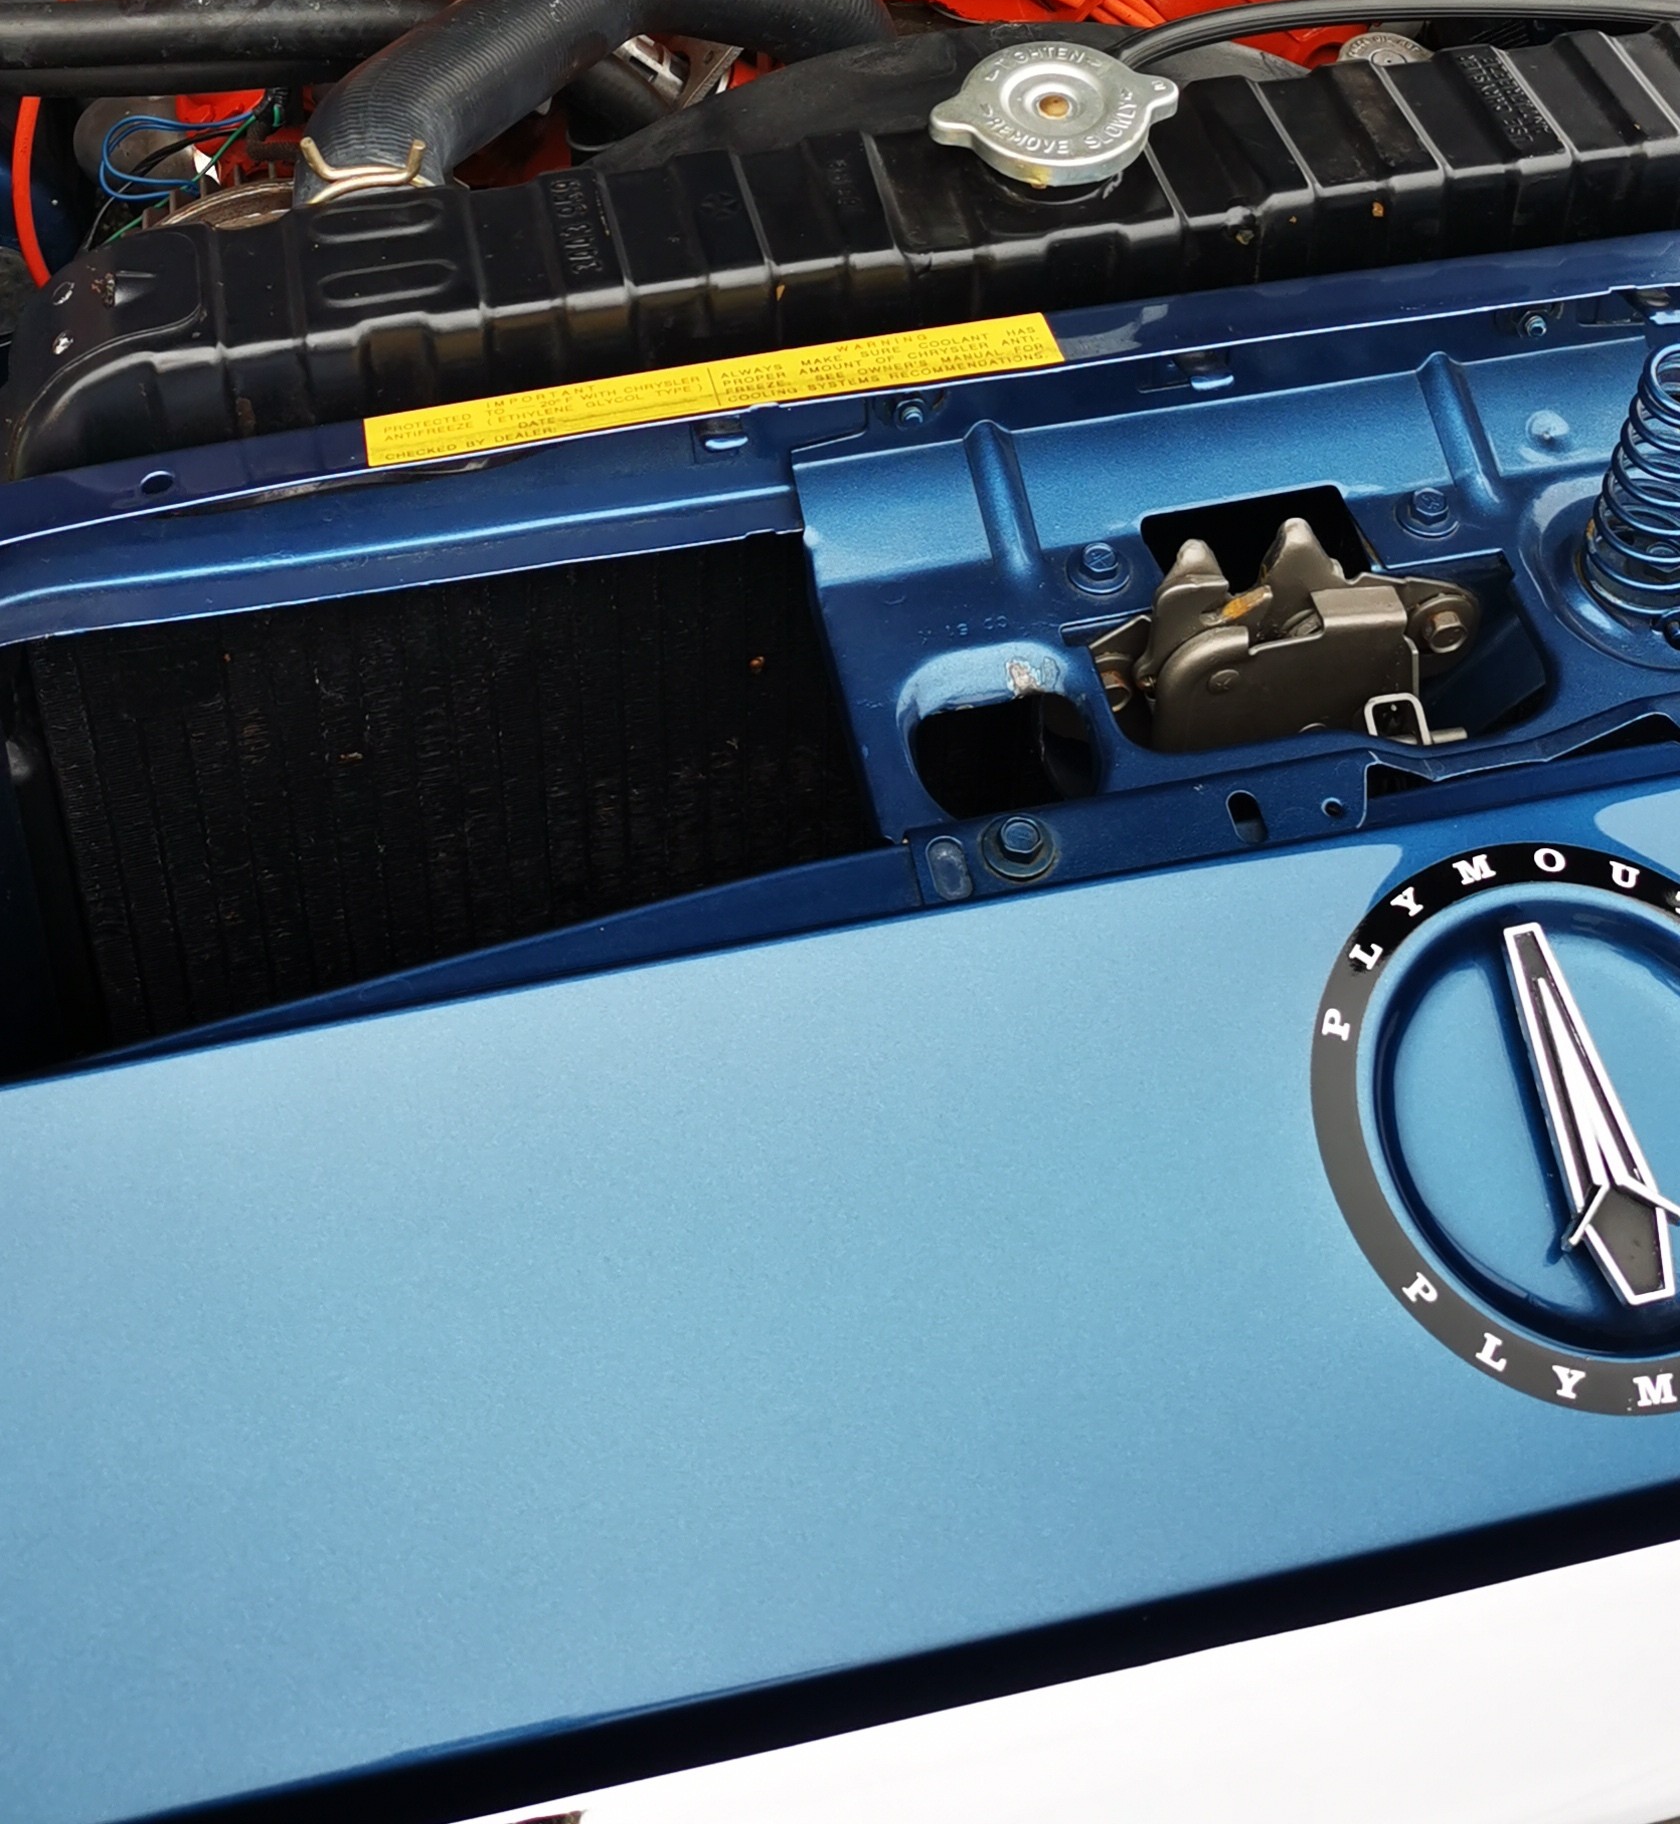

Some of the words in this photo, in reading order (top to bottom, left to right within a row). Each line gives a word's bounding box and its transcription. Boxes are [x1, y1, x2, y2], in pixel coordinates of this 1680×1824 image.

[986, 117, 1069, 155] REMOVE
[721, 363, 783, 378] ALWAYS
[801, 354, 843, 367] MAKE
[860, 346, 902, 359] SURE
[918, 333, 989, 350] COOLANT
[1006, 326, 1037, 337] HAS
[723, 371, 786, 387] PROPER
[799, 360, 862, 376] AMOUNT
[876, 354, 896, 365] OF
[907, 342, 989, 361] CHRYSLER
[1001, 335, 1040, 347] ANTI-
[836, 333, 929, 353] WARNING
[815, 371, 844, 383] SEE
[859, 359, 928, 377] OWNER'S
[942, 349, 1003, 365] MANUAL
[1014, 343, 1045, 355] FOR
[384, 412, 472, 434] PROTECTED
[486, 407, 506, 418] TO
[580, 388, 617, 401] WITH
[623, 375, 702, 394] CHRYSLER
[486, 384, 597, 409] IMPORTANT
[727, 387, 799, 404] COOLING
[807, 375, 881, 392] SYSTEMS
[384, 419, 475, 442] ANTIFREEZE
[585, 394, 644, 409] GLYCOL
[518, 417, 556, 429] DATE
[384, 442, 458, 461] CHECKED
[466, 437, 487, 449] BY
[1321, 848, 1680, 1041] PLYMOU
